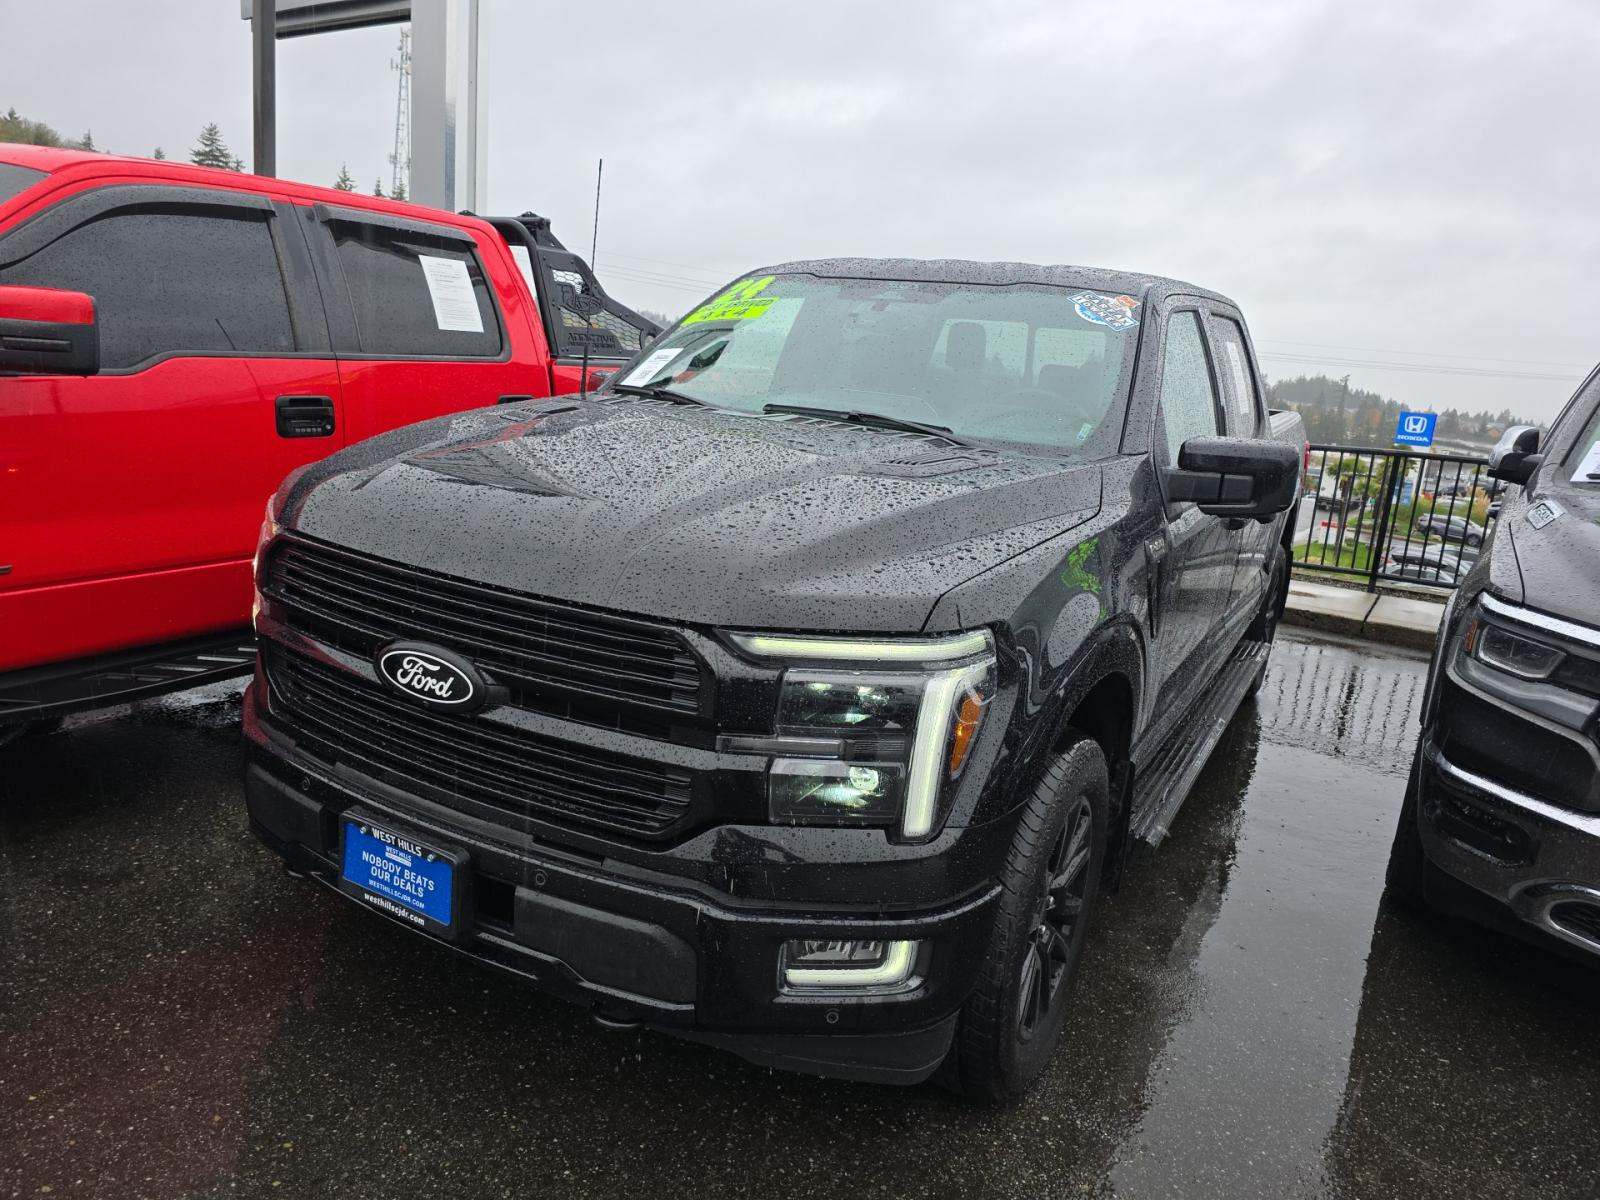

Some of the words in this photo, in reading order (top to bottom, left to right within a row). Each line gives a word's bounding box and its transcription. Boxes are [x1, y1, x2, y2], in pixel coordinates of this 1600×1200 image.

[1397, 434, 1429, 442] HONDA
[396, 656, 454, 698] Ford
[371, 827, 396, 845] WEST
[397, 838, 422, 857] HILLS
[385, 845, 399, 855] WEST
[398, 851, 412, 862] HILLS
[362, 850, 401, 875] NOBODY
[404, 869, 435, 891] BEATS
[370, 866, 391, 883] OUR
[393, 876, 424, 897] DEALS
[368, 879, 425, 909] WESTHILLSCJDR.COM
[364, 893, 425, 926] westhillscjdr.com
